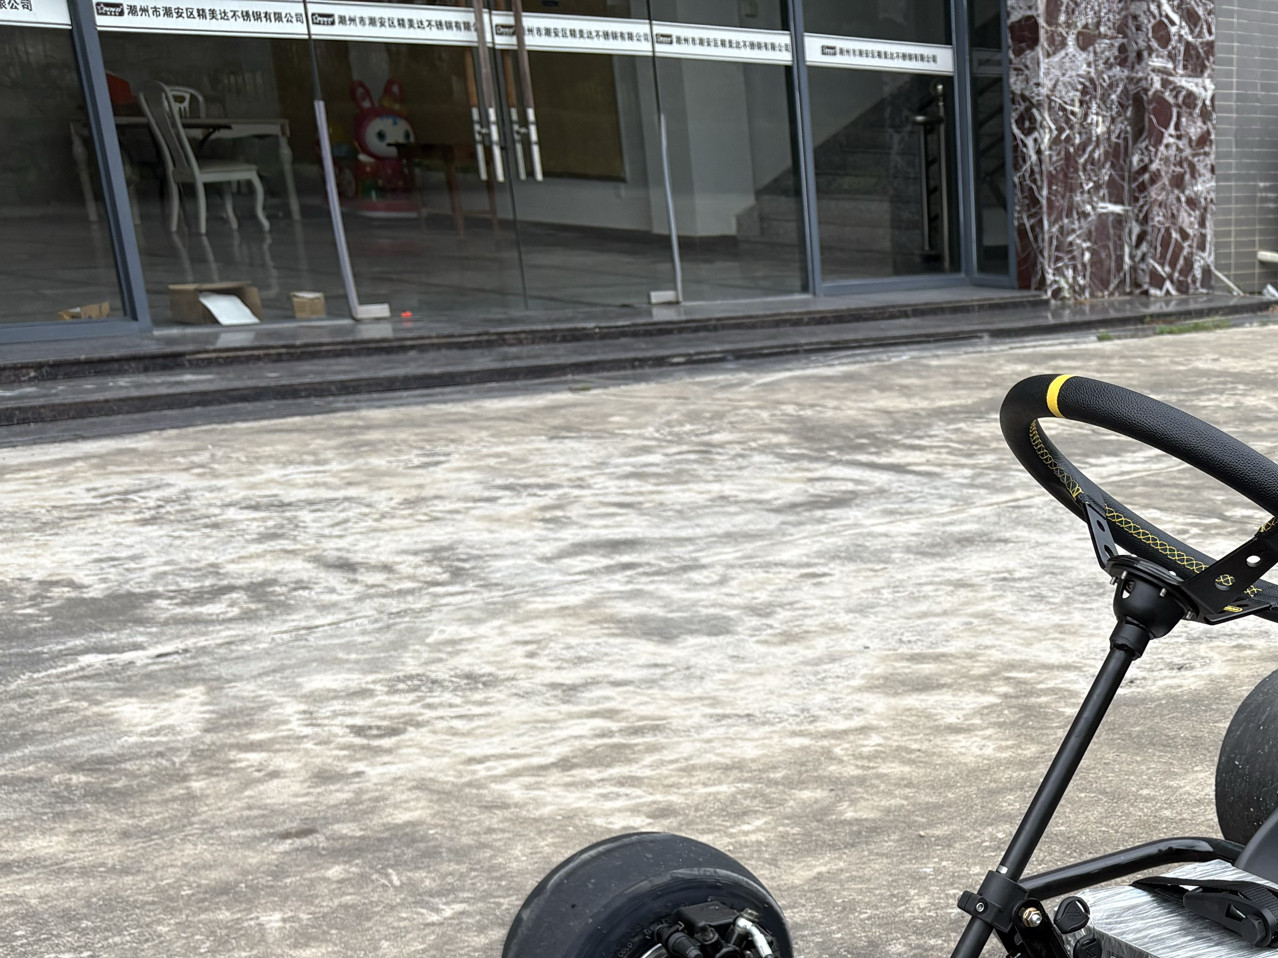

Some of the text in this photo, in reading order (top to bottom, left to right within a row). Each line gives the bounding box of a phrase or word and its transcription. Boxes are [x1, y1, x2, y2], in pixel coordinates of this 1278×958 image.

[126, 3, 305, 25] 潮州市潮安区精美达不锈钢有限公司
[337, 14, 478, 33] 潮州市潮安区精美达不锈钢有限
[524, 25, 651, 43] 州市潮安区精美达不锈钢有限公司
